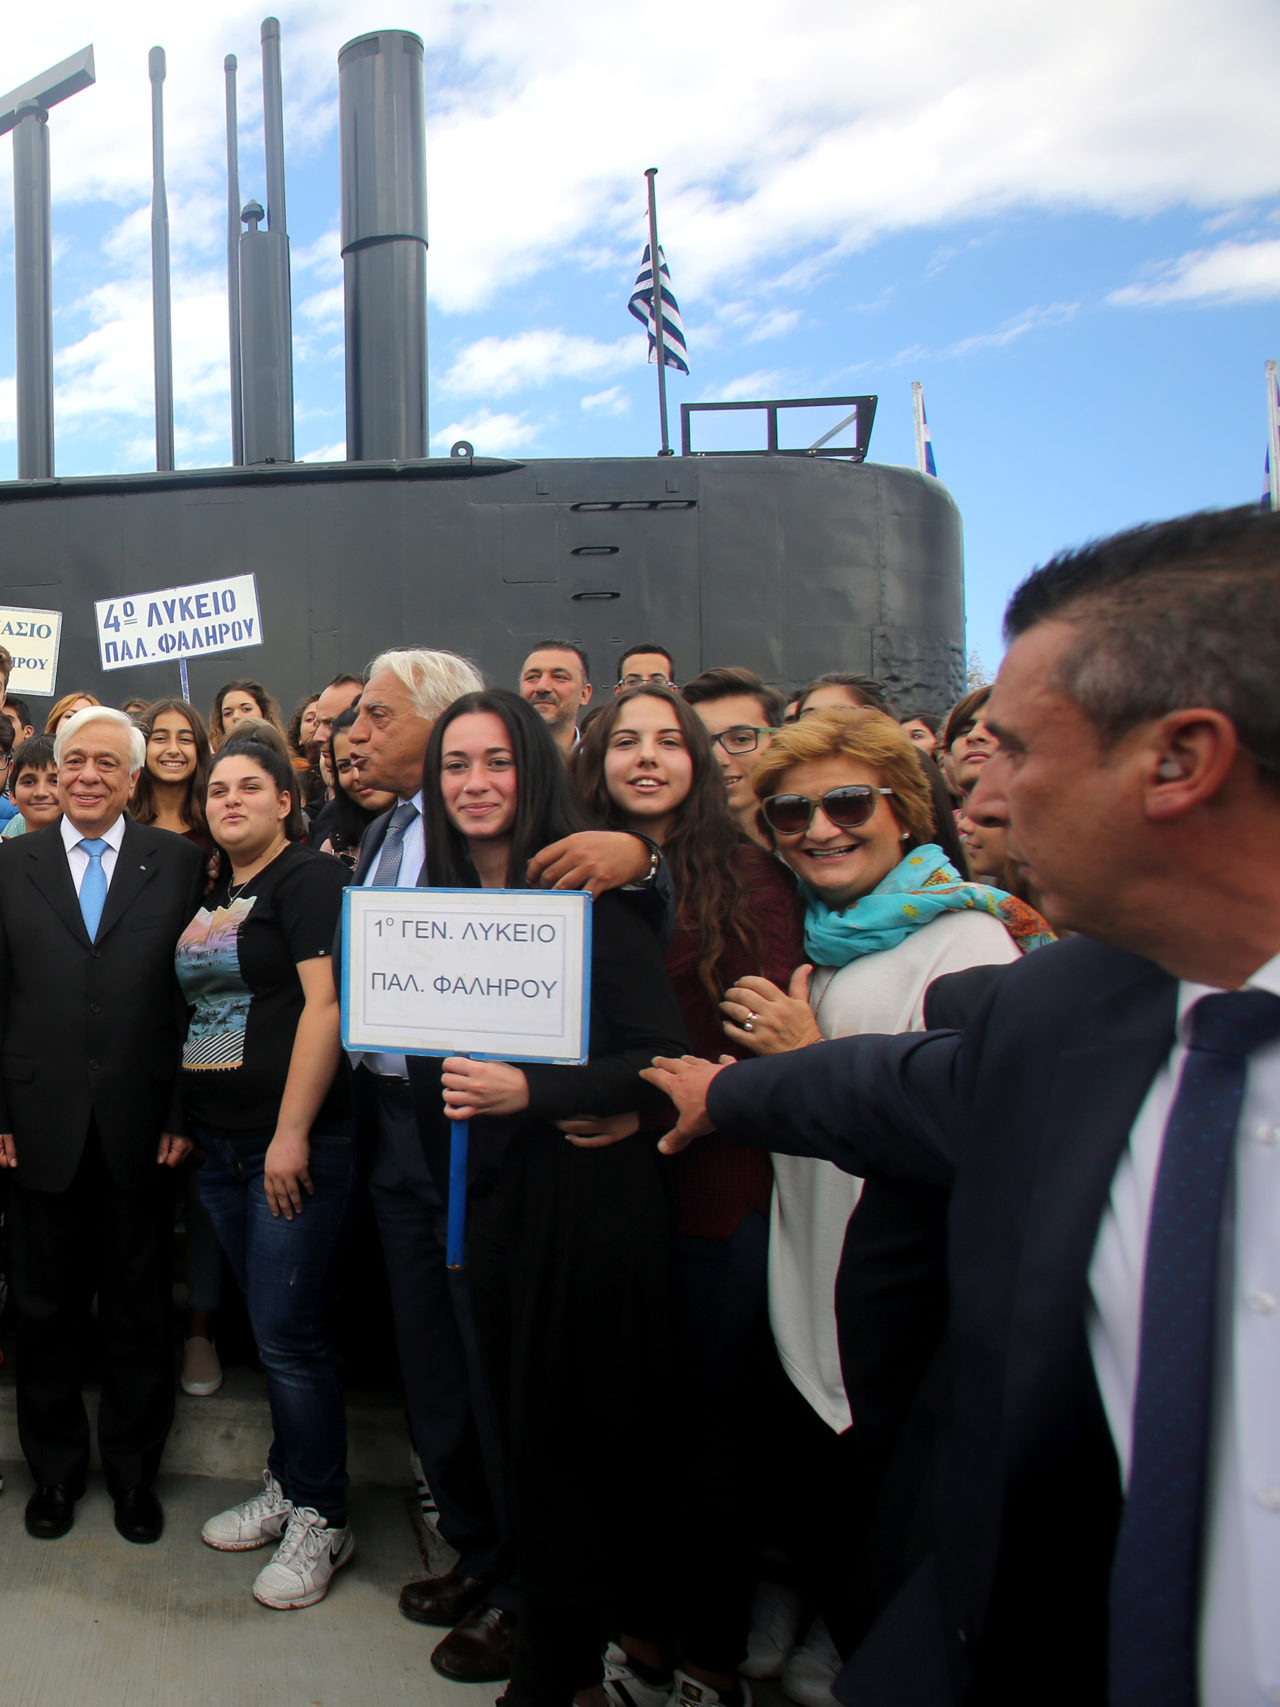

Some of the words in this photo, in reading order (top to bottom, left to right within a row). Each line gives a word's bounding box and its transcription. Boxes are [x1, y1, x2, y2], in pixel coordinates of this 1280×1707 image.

[147, 589, 236, 627] ΛΥΚΕΙΟ
[105, 637, 156, 663] ΠΑΛ.
[158, 618, 254, 653] ΦΑΛΗΡΟΥ
[401, 920, 454, 940] ΓΕΝ.
[461, 922, 556, 943] ΛΥΚΕΙΟ
[371, 972, 425, 993] ΠΑΛ.
[433, 975, 558, 999] ΦΑΛΗΡΟΥ
